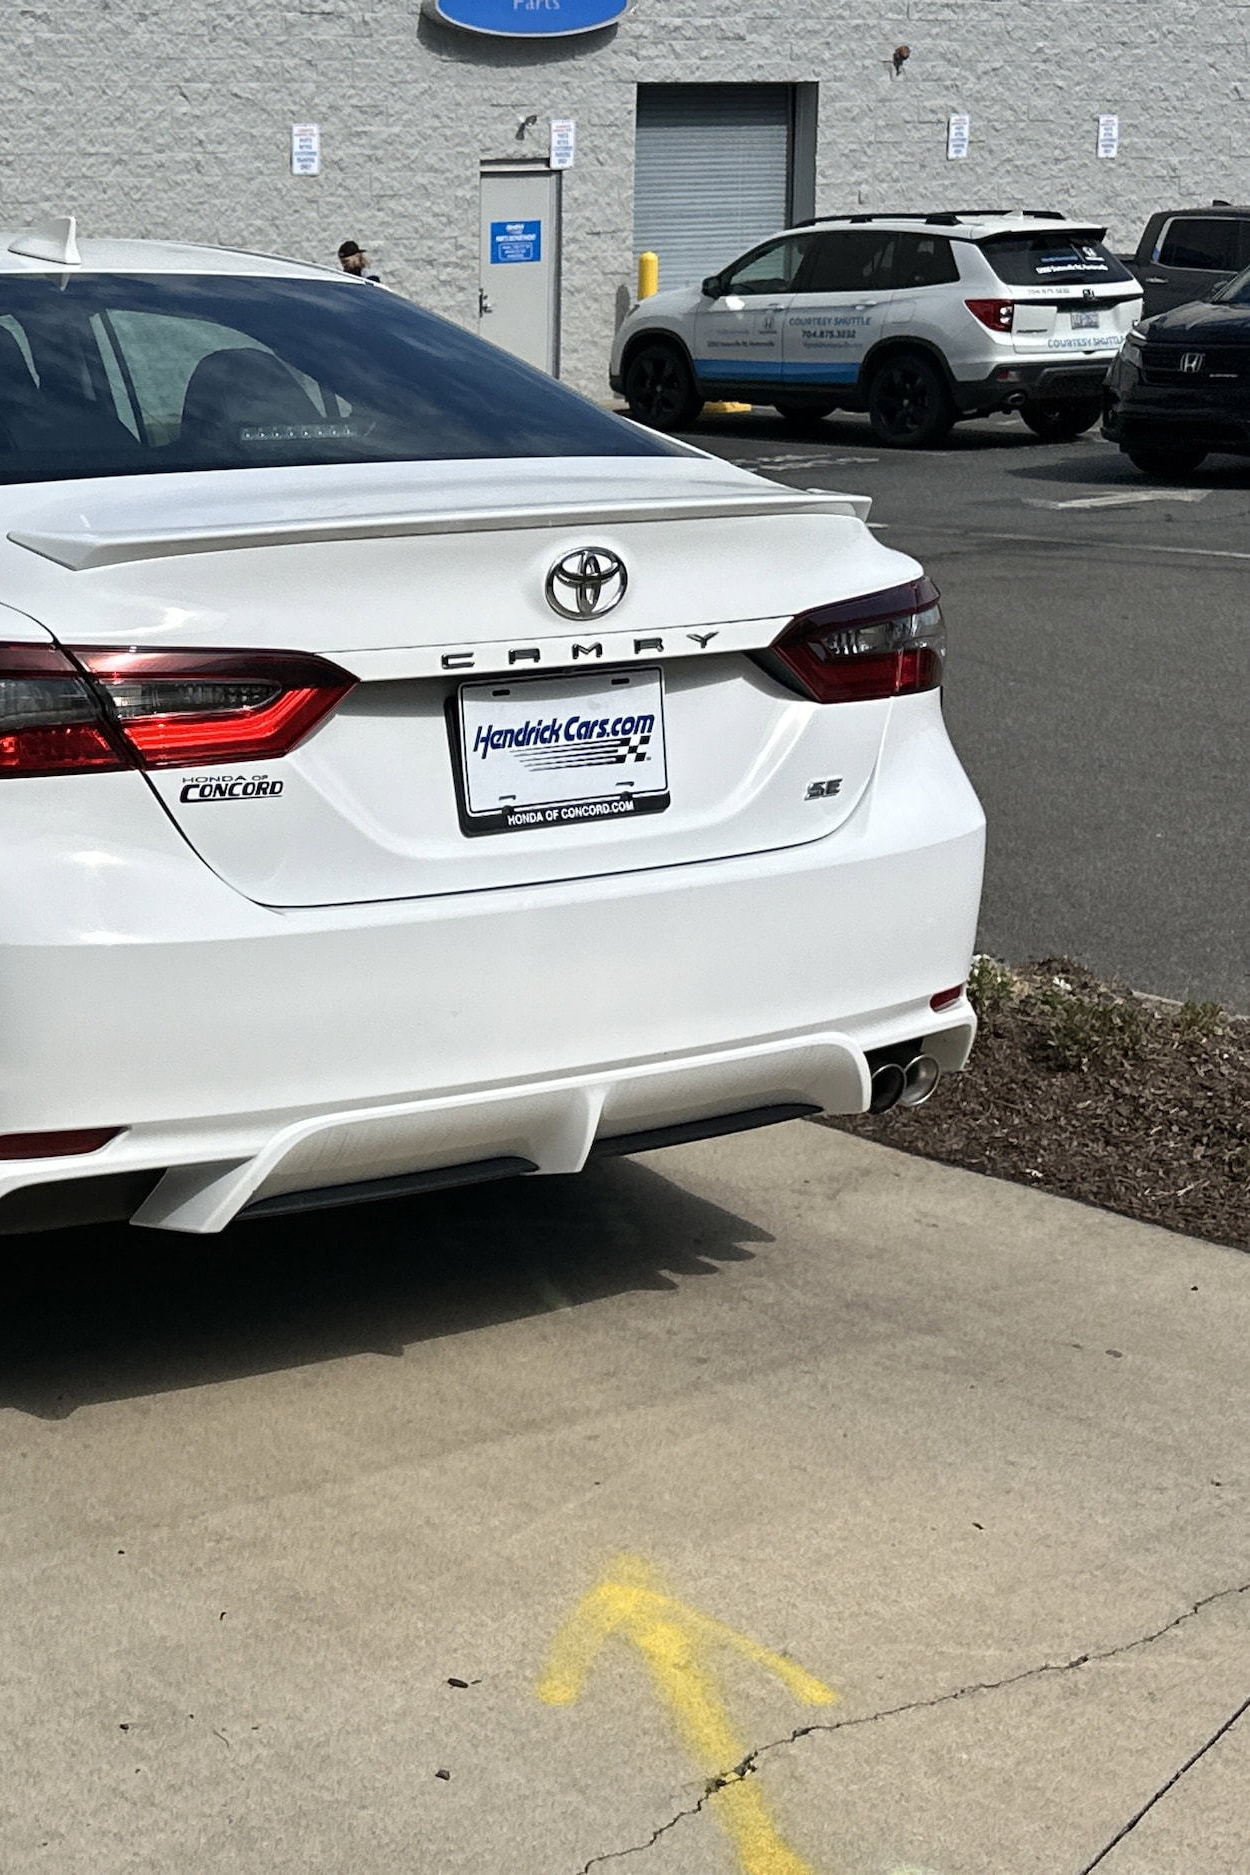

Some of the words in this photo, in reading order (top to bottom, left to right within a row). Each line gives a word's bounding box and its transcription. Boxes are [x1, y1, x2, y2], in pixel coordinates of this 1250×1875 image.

[513, 0, 560, 10] Parts
[789, 316, 833, 327] COURTESY
[833, 315, 872, 326] SHUTTLE
[801, 329, 857, 339] 704.875.3232
[1047, 335, 1092, 349] COURTESY
[441, 631, 719, 670] CAMRY
[181, 775, 247, 783] HONDA
[179, 780, 284, 803] CONCORD
[804, 777, 844, 802] SE
[507, 811, 544, 826] HONDA
[545, 808, 560, 821] OF
[561, 800, 635, 820] CONCORD.COM
